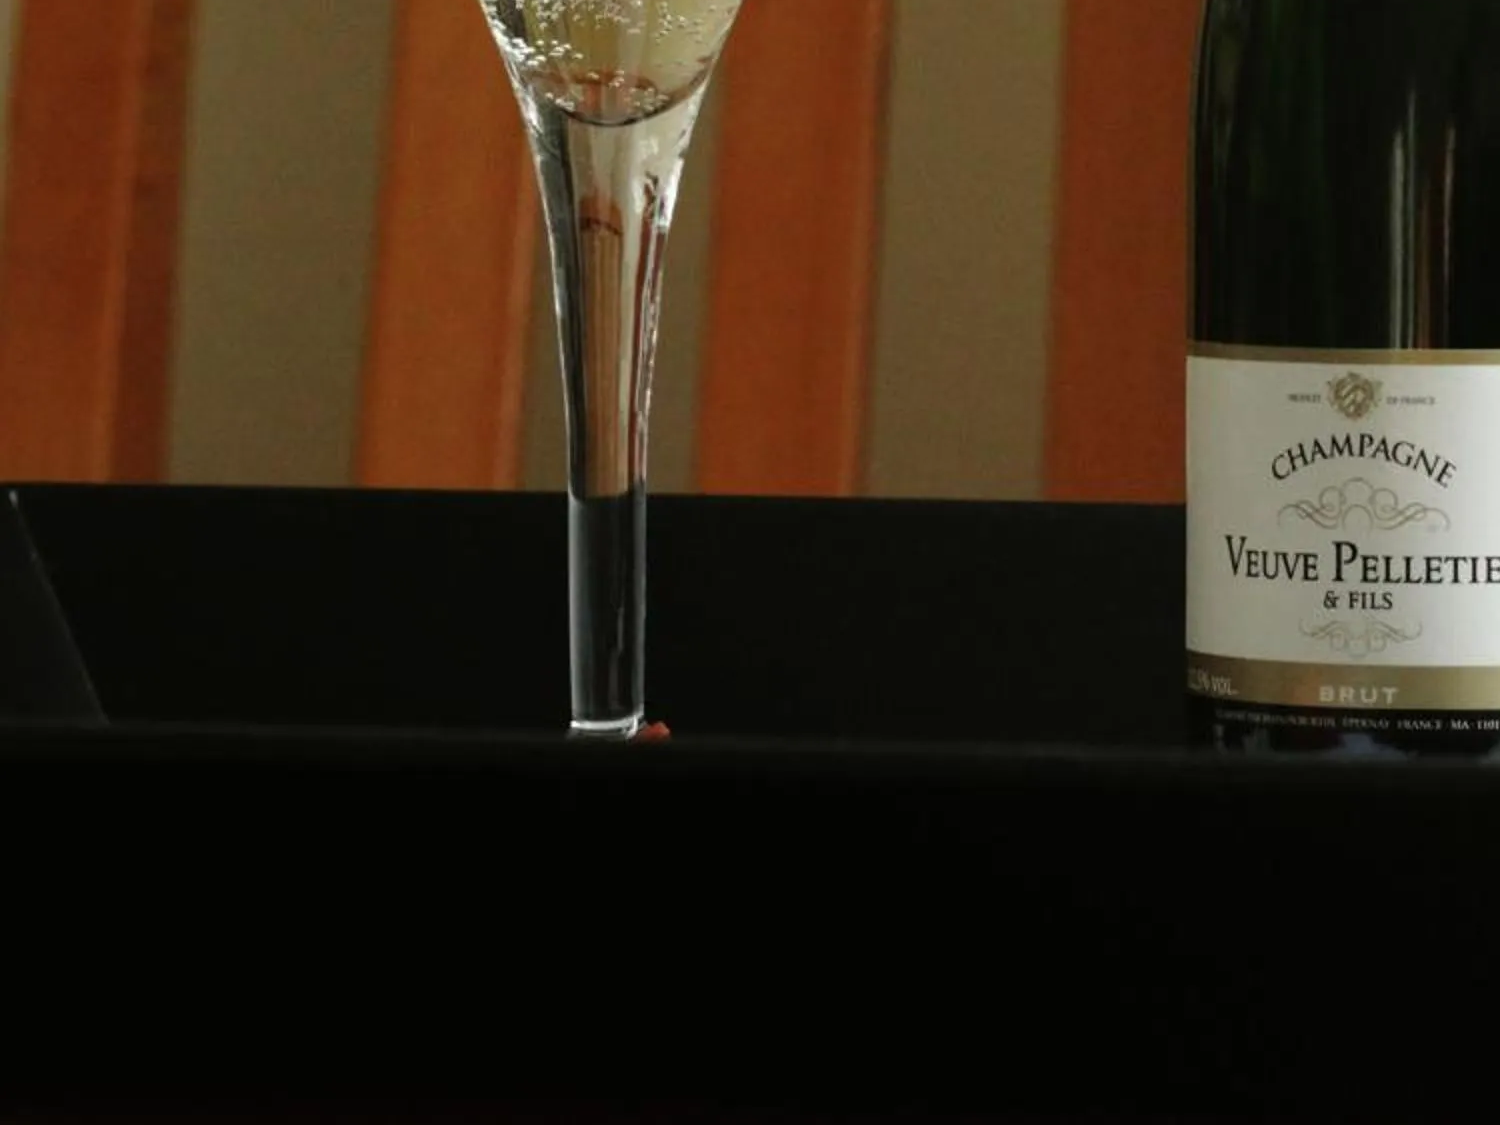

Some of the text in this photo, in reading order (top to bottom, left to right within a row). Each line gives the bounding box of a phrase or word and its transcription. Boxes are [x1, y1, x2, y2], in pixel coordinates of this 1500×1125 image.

[1270, 432, 1457, 489] CHAMPAGNE
[1225, 534, 1319, 582] VEUVE
[1323, 590, 1394, 610] & FILS
[1318, 685, 1399, 704] BRUT
